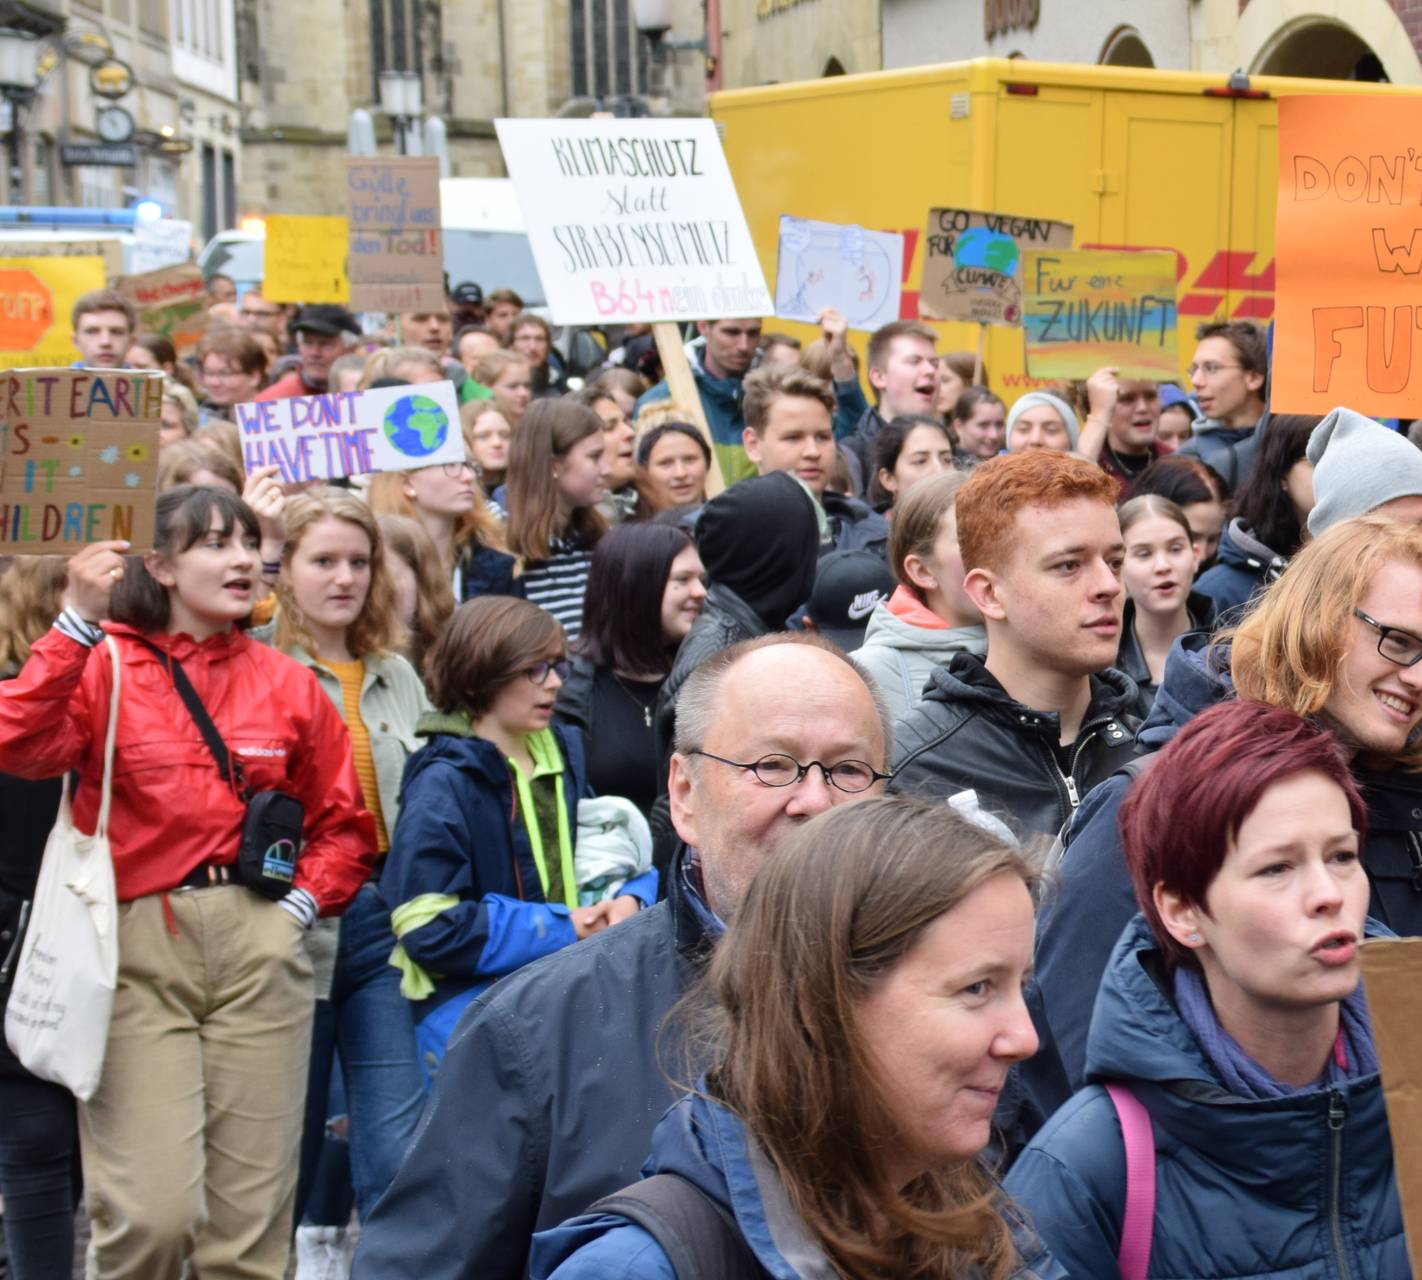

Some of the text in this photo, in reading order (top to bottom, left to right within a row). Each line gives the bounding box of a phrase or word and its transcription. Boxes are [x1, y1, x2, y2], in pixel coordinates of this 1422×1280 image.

[551, 136, 704, 177] KLIMASCHUTZ
[938, 209, 1052, 242] GO VEGAN
[1036, 295, 1175, 347] ZUKUNFT
[70, 375, 164, 419] EARTH
[238, 400, 281, 435] WE
[245, 428, 383, 484] HAVE TIME
[24, 459, 60, 493] IT
[854, 589, 880, 609] NIKE
